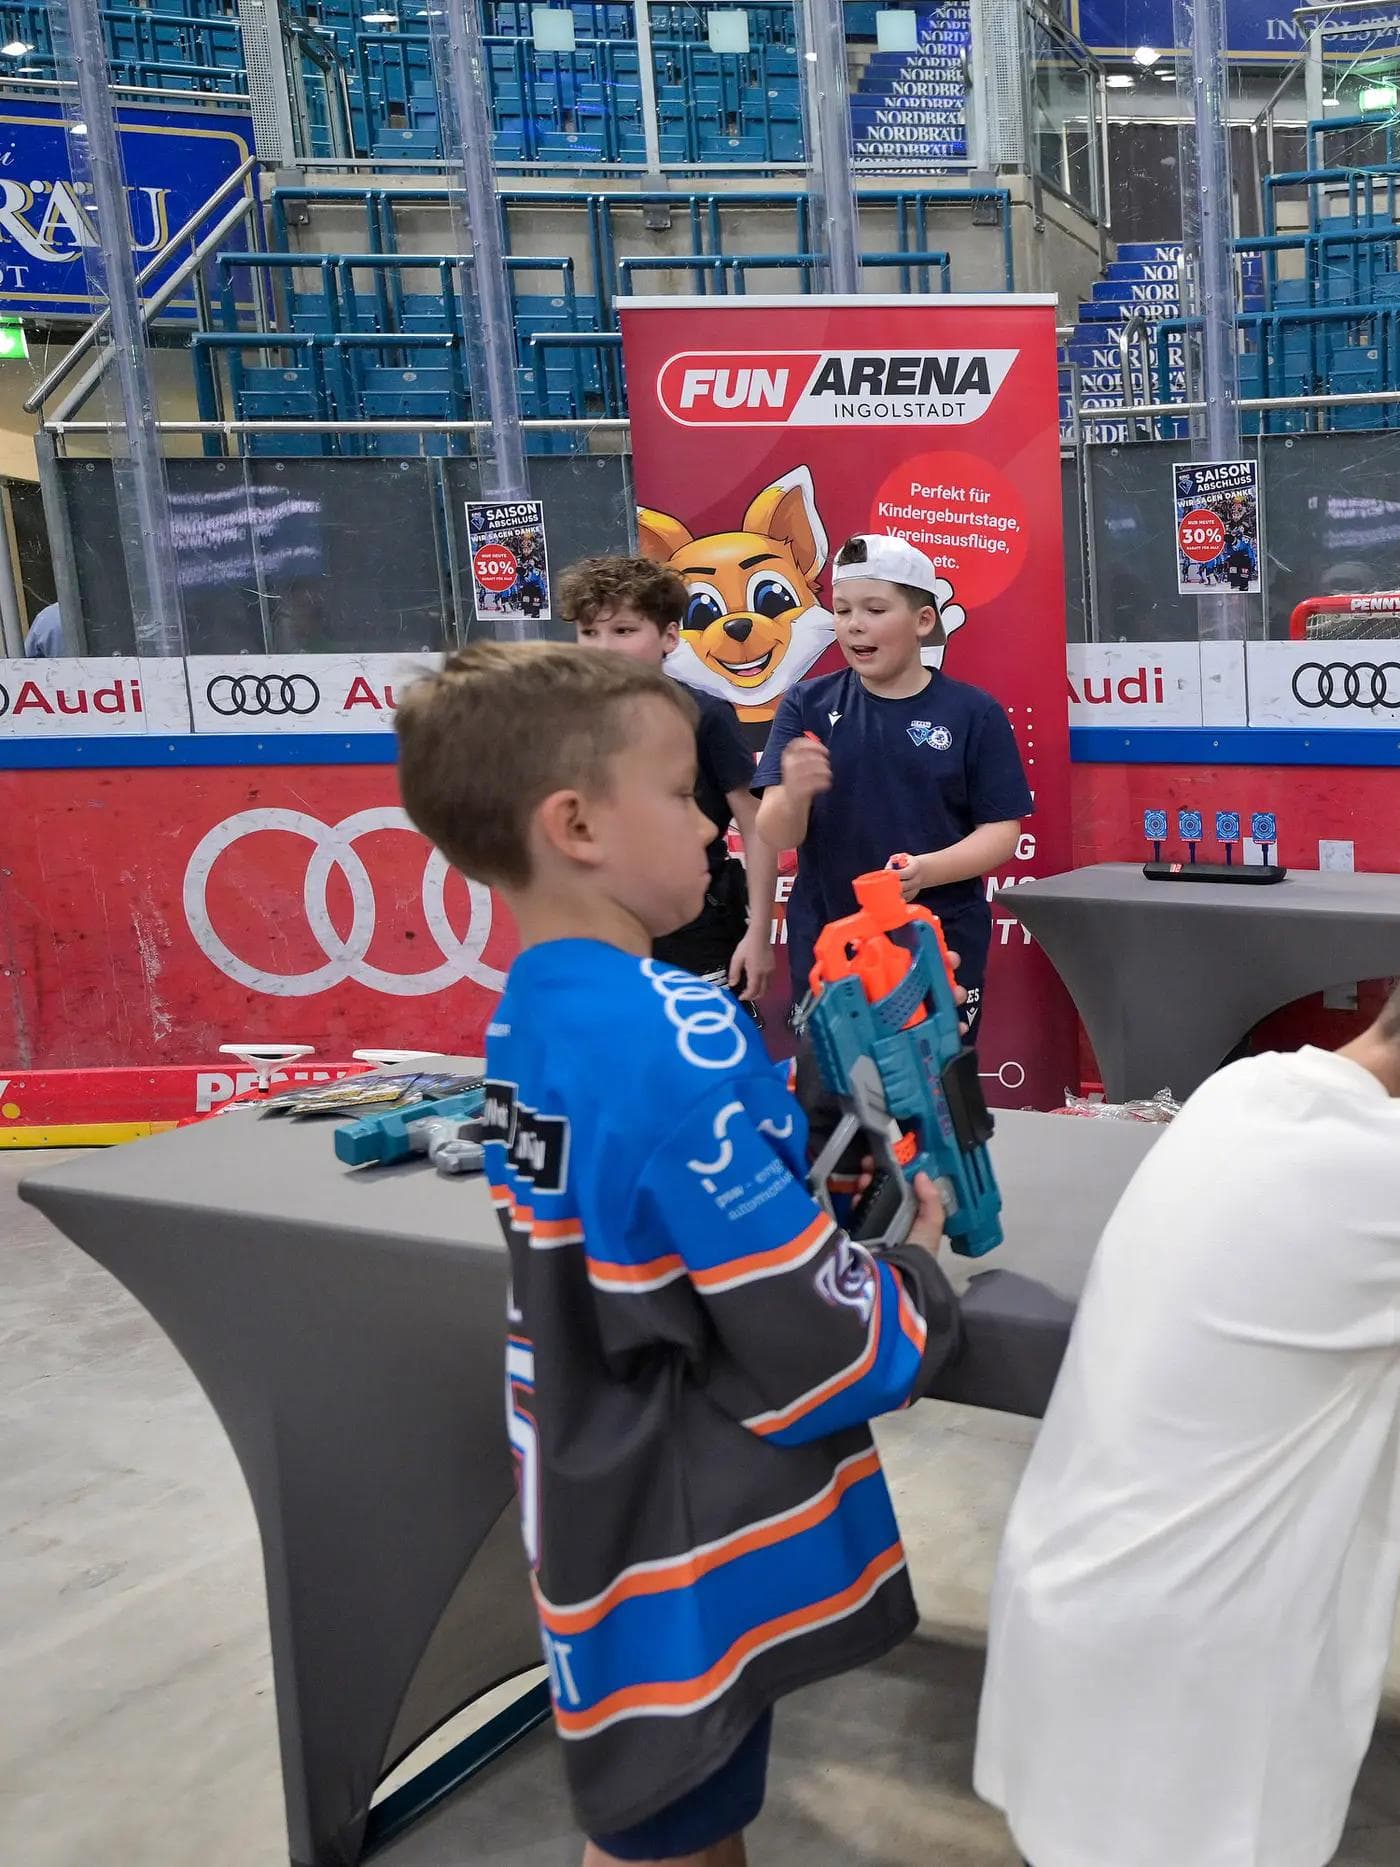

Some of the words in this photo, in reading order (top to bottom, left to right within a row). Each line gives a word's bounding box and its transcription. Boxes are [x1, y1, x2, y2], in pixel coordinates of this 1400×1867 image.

[867, 125, 963, 142] NORDBRÄU
[680, 368, 790, 409] FUN
[810, 356, 993, 397] ARENA
[833, 402, 967, 419] INGOLSTADT
[1195, 463, 1251, 484] SAISON
[910, 482, 965, 501] Perfekt
[969, 487, 991, 503] für
[1197, 475, 1252, 493] ABSCHLUSS
[1178, 499, 1194, 508] WIR
[1196, 493, 1223, 505] SAGEN
[1224, 488, 1253, 500] DANKE
[486, 503, 538, 521] SAISON
[878, 502, 1021, 532] Kindergeburtstage,
[488, 514, 539, 529] ABSCHLUSS
[471, 534, 486, 543] WIR
[488, 530, 513, 541] SAGEN
[886, 526, 1010, 553] Vereinsausflüge,
[1182, 528, 1222, 544] 30%
[477, 561, 515, 575] 30%
[933, 555, 960, 569] etc.
[12, 679, 144, 715] Audi
[343, 676, 401, 710] Au
[966, 988, 980, 1003] ES
